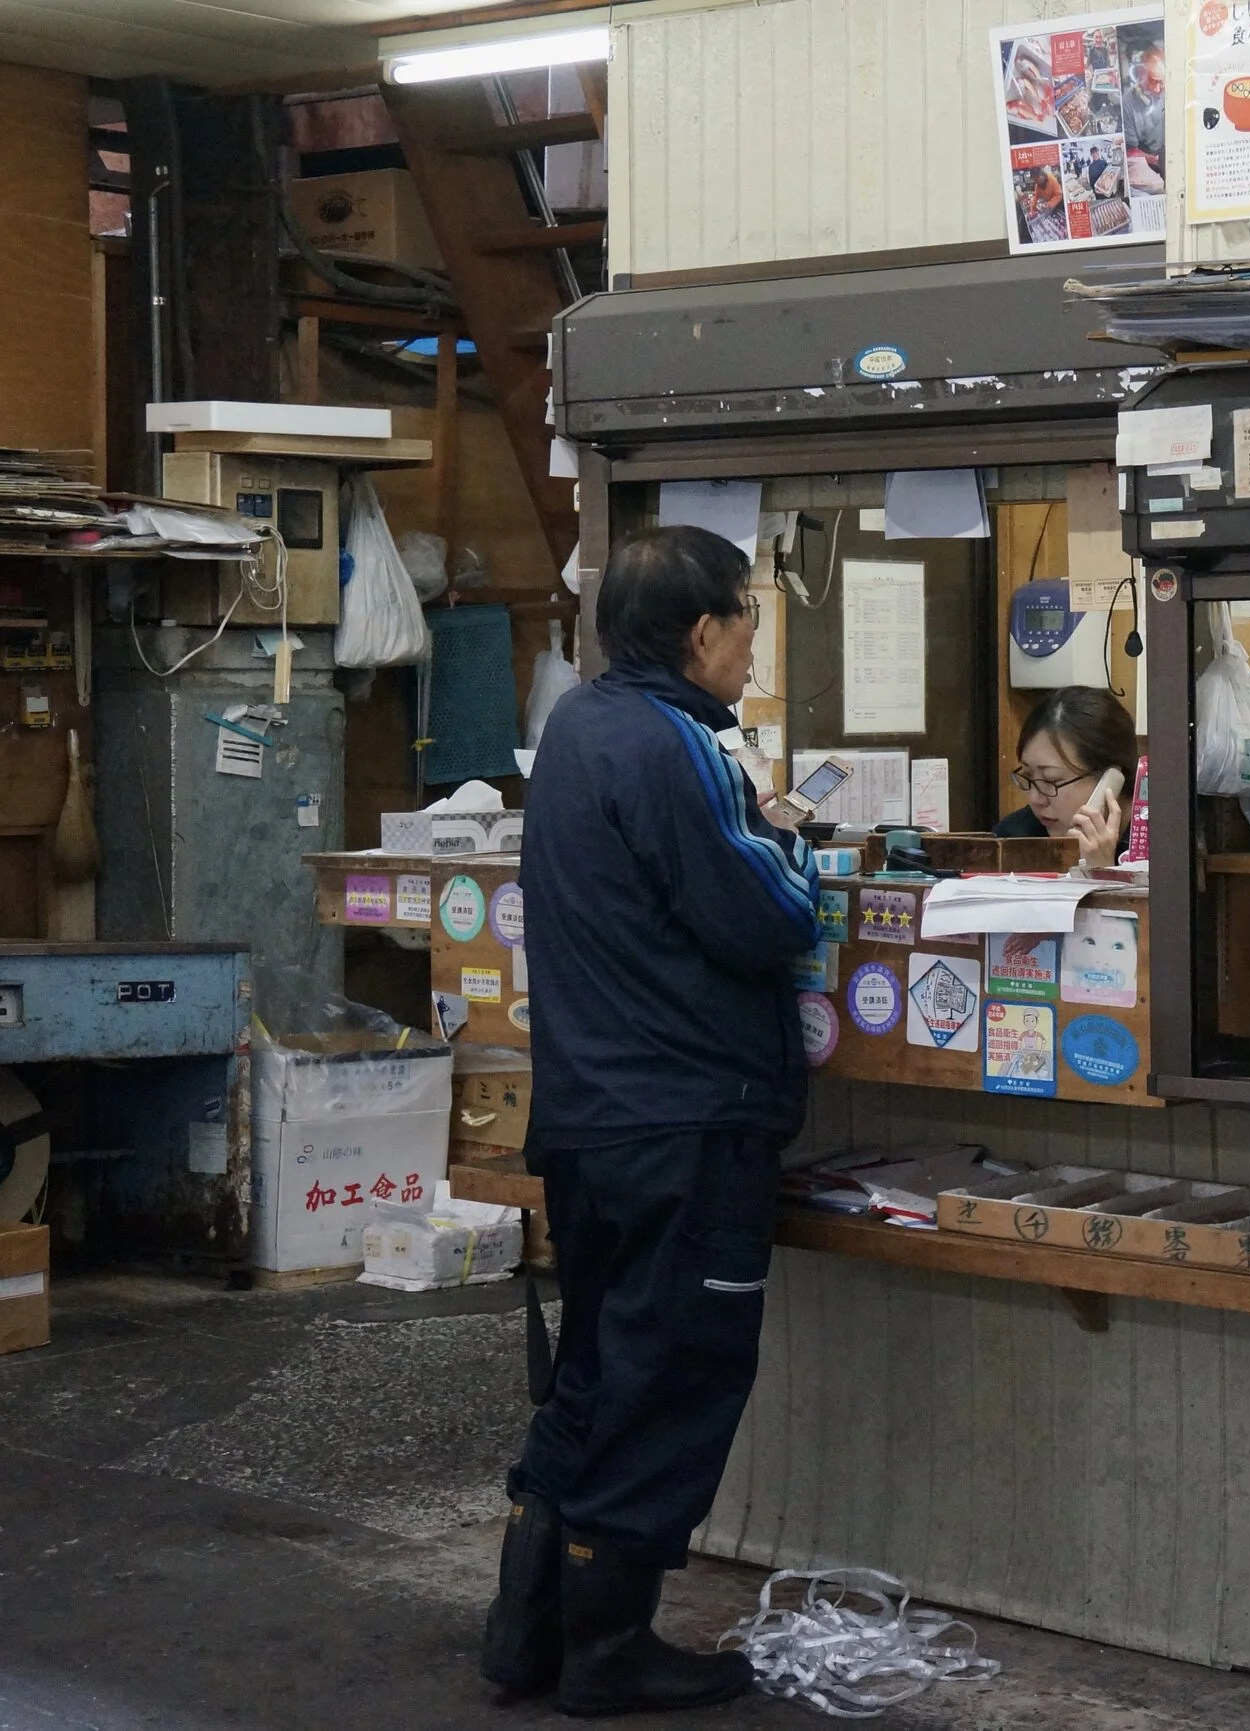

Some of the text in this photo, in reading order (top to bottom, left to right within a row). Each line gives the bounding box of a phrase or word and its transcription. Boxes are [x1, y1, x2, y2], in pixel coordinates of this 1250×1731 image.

[118, 984, 170, 1000] POT
[305, 1173, 424, 1212] 加工食品
